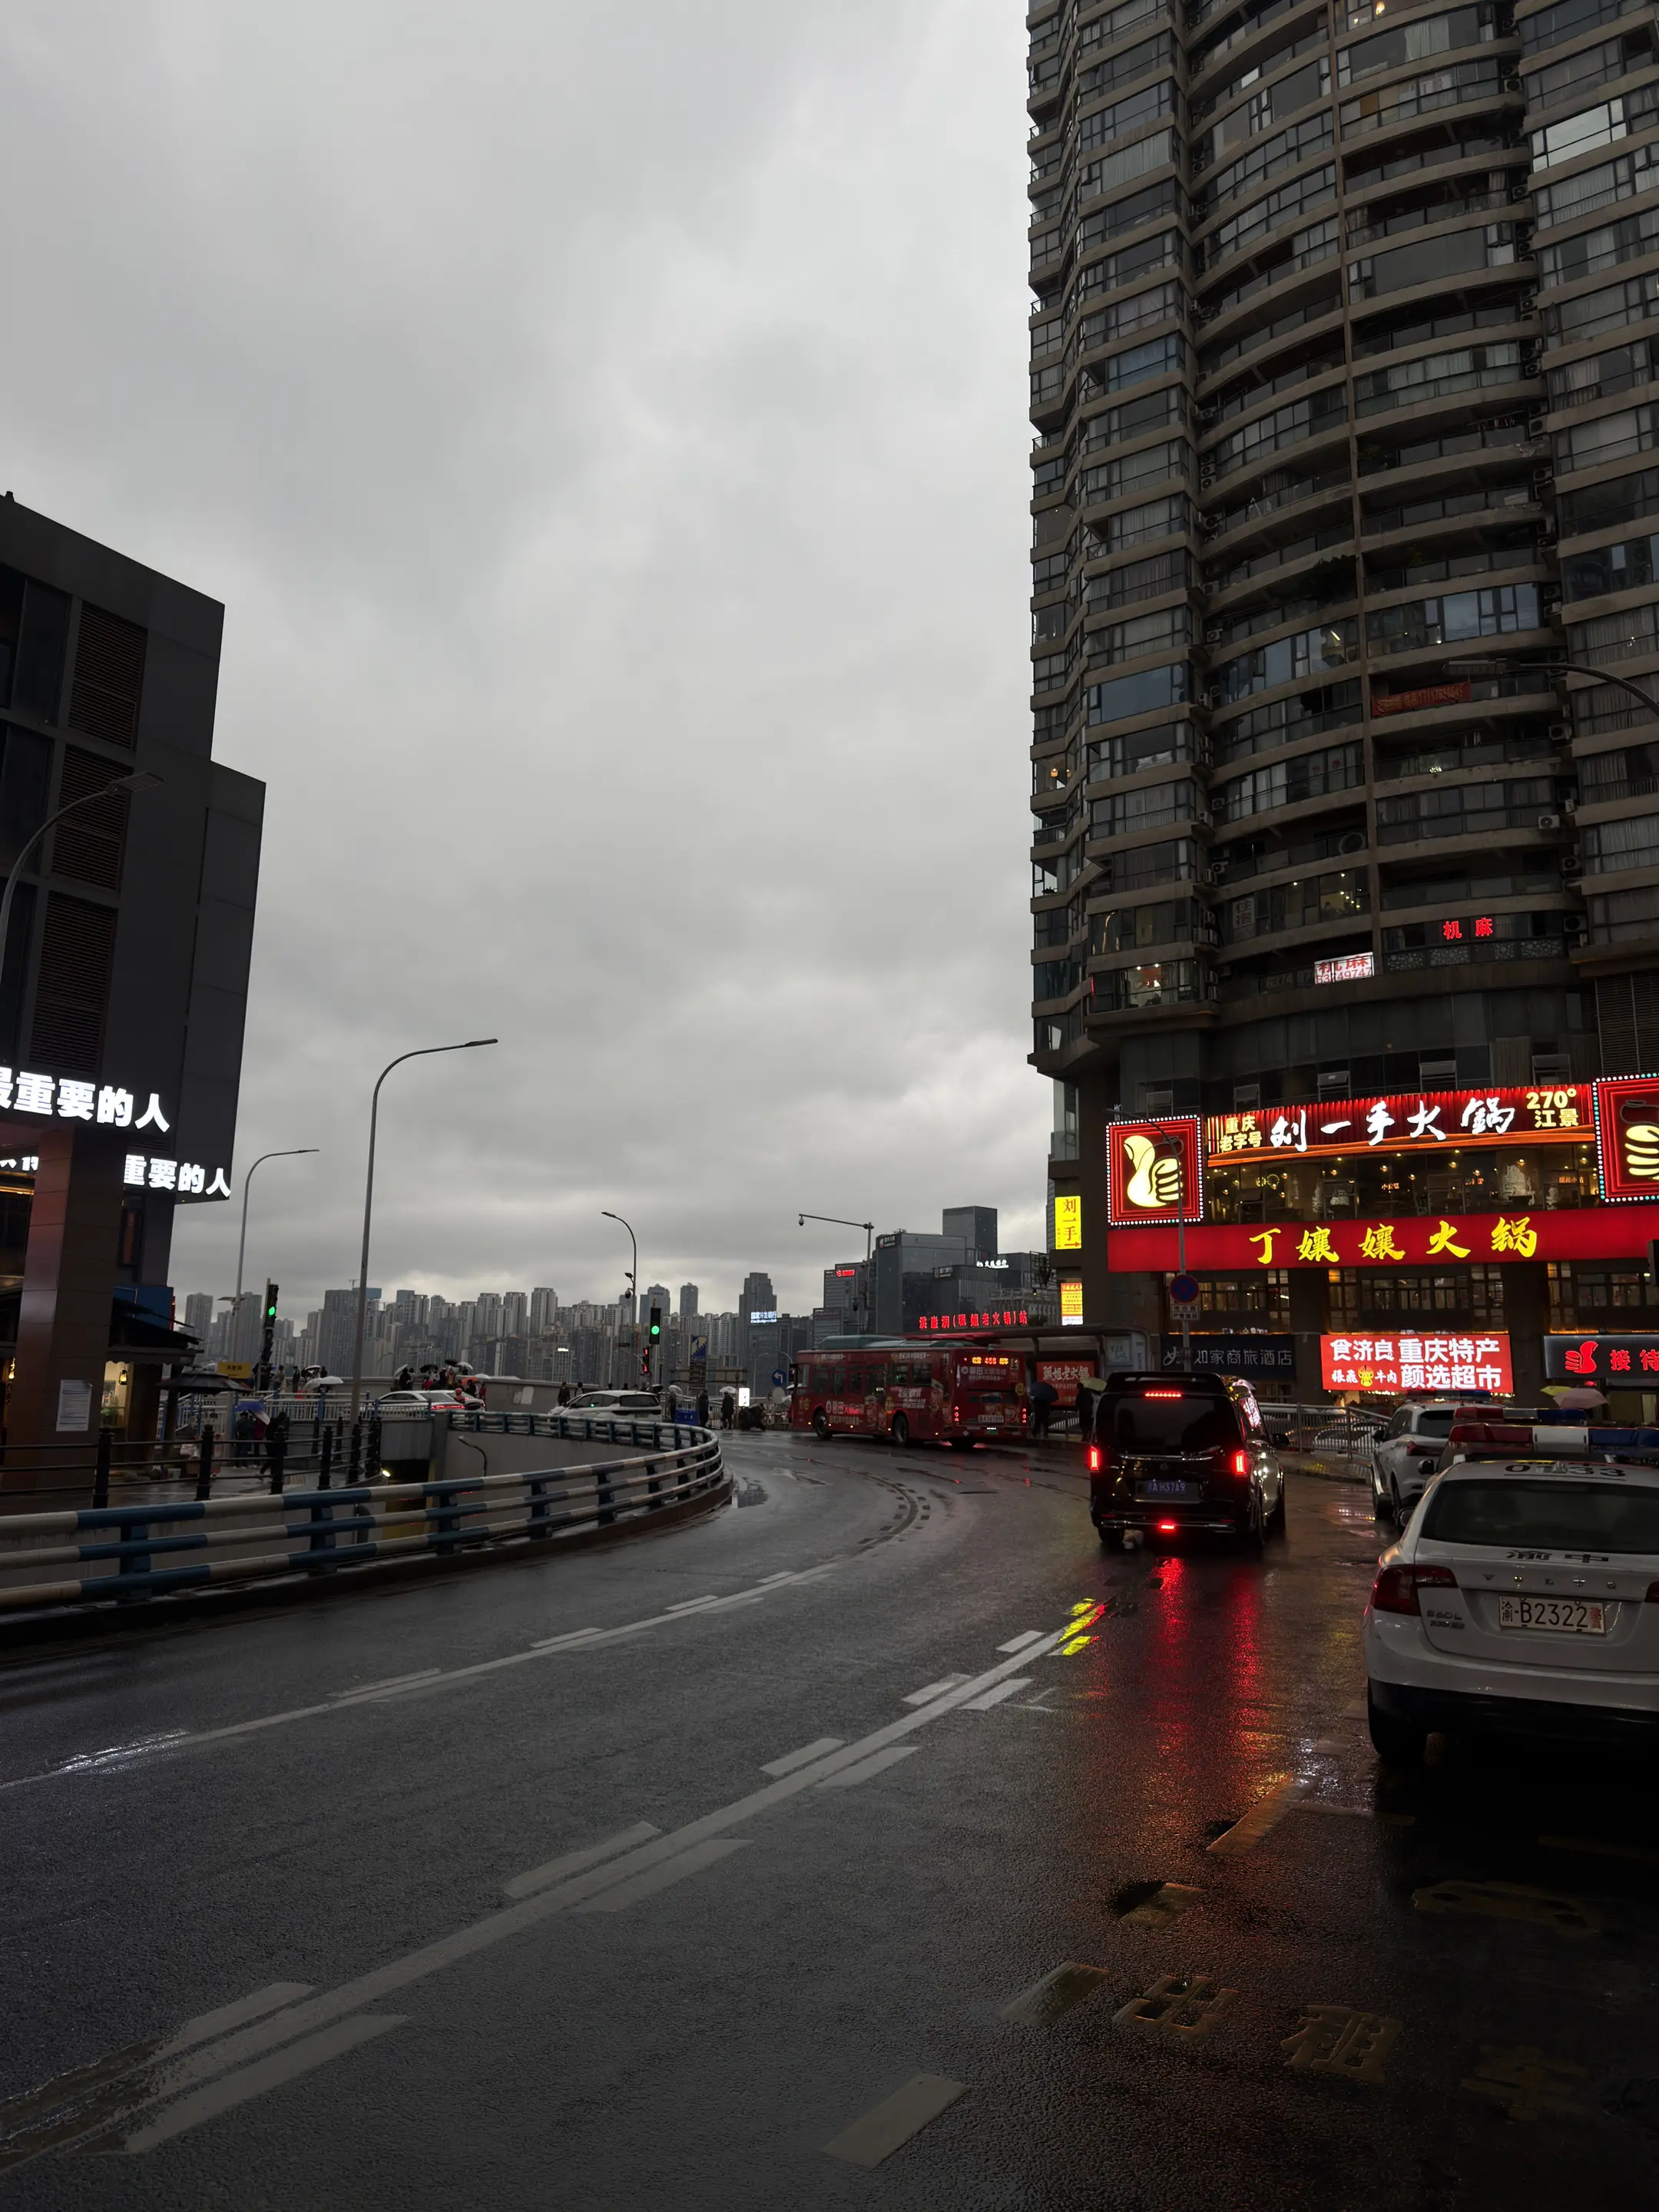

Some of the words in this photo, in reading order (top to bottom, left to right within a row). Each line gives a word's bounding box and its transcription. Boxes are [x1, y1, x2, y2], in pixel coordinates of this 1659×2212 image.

[1443, 917, 1493, 940] 机麻
[1316, 967, 1372, 985] 6349747
[1525, 1088, 1578, 1110] 270°
[1224, 1114, 1256, 1134] 重庆
[1534, 1108, 1579, 1128] 江景
[1219, 1131, 1263, 1152] 老字号
[123, 1154, 231, 1197] 重要的人
[1063, 1198, 1078, 1241] 刘一手
[1194, 1348, 1293, 1366] 如家商旅酒店
[1330, 1338, 1395, 1362] 食济良
[1398, 1337, 1501, 1363] 重庆特产
[1609, 1349, 1659, 1372] 接待
[1374, 1369, 1398, 1384] 牛肉
[1400, 1364, 1502, 1389] 颜选超市
